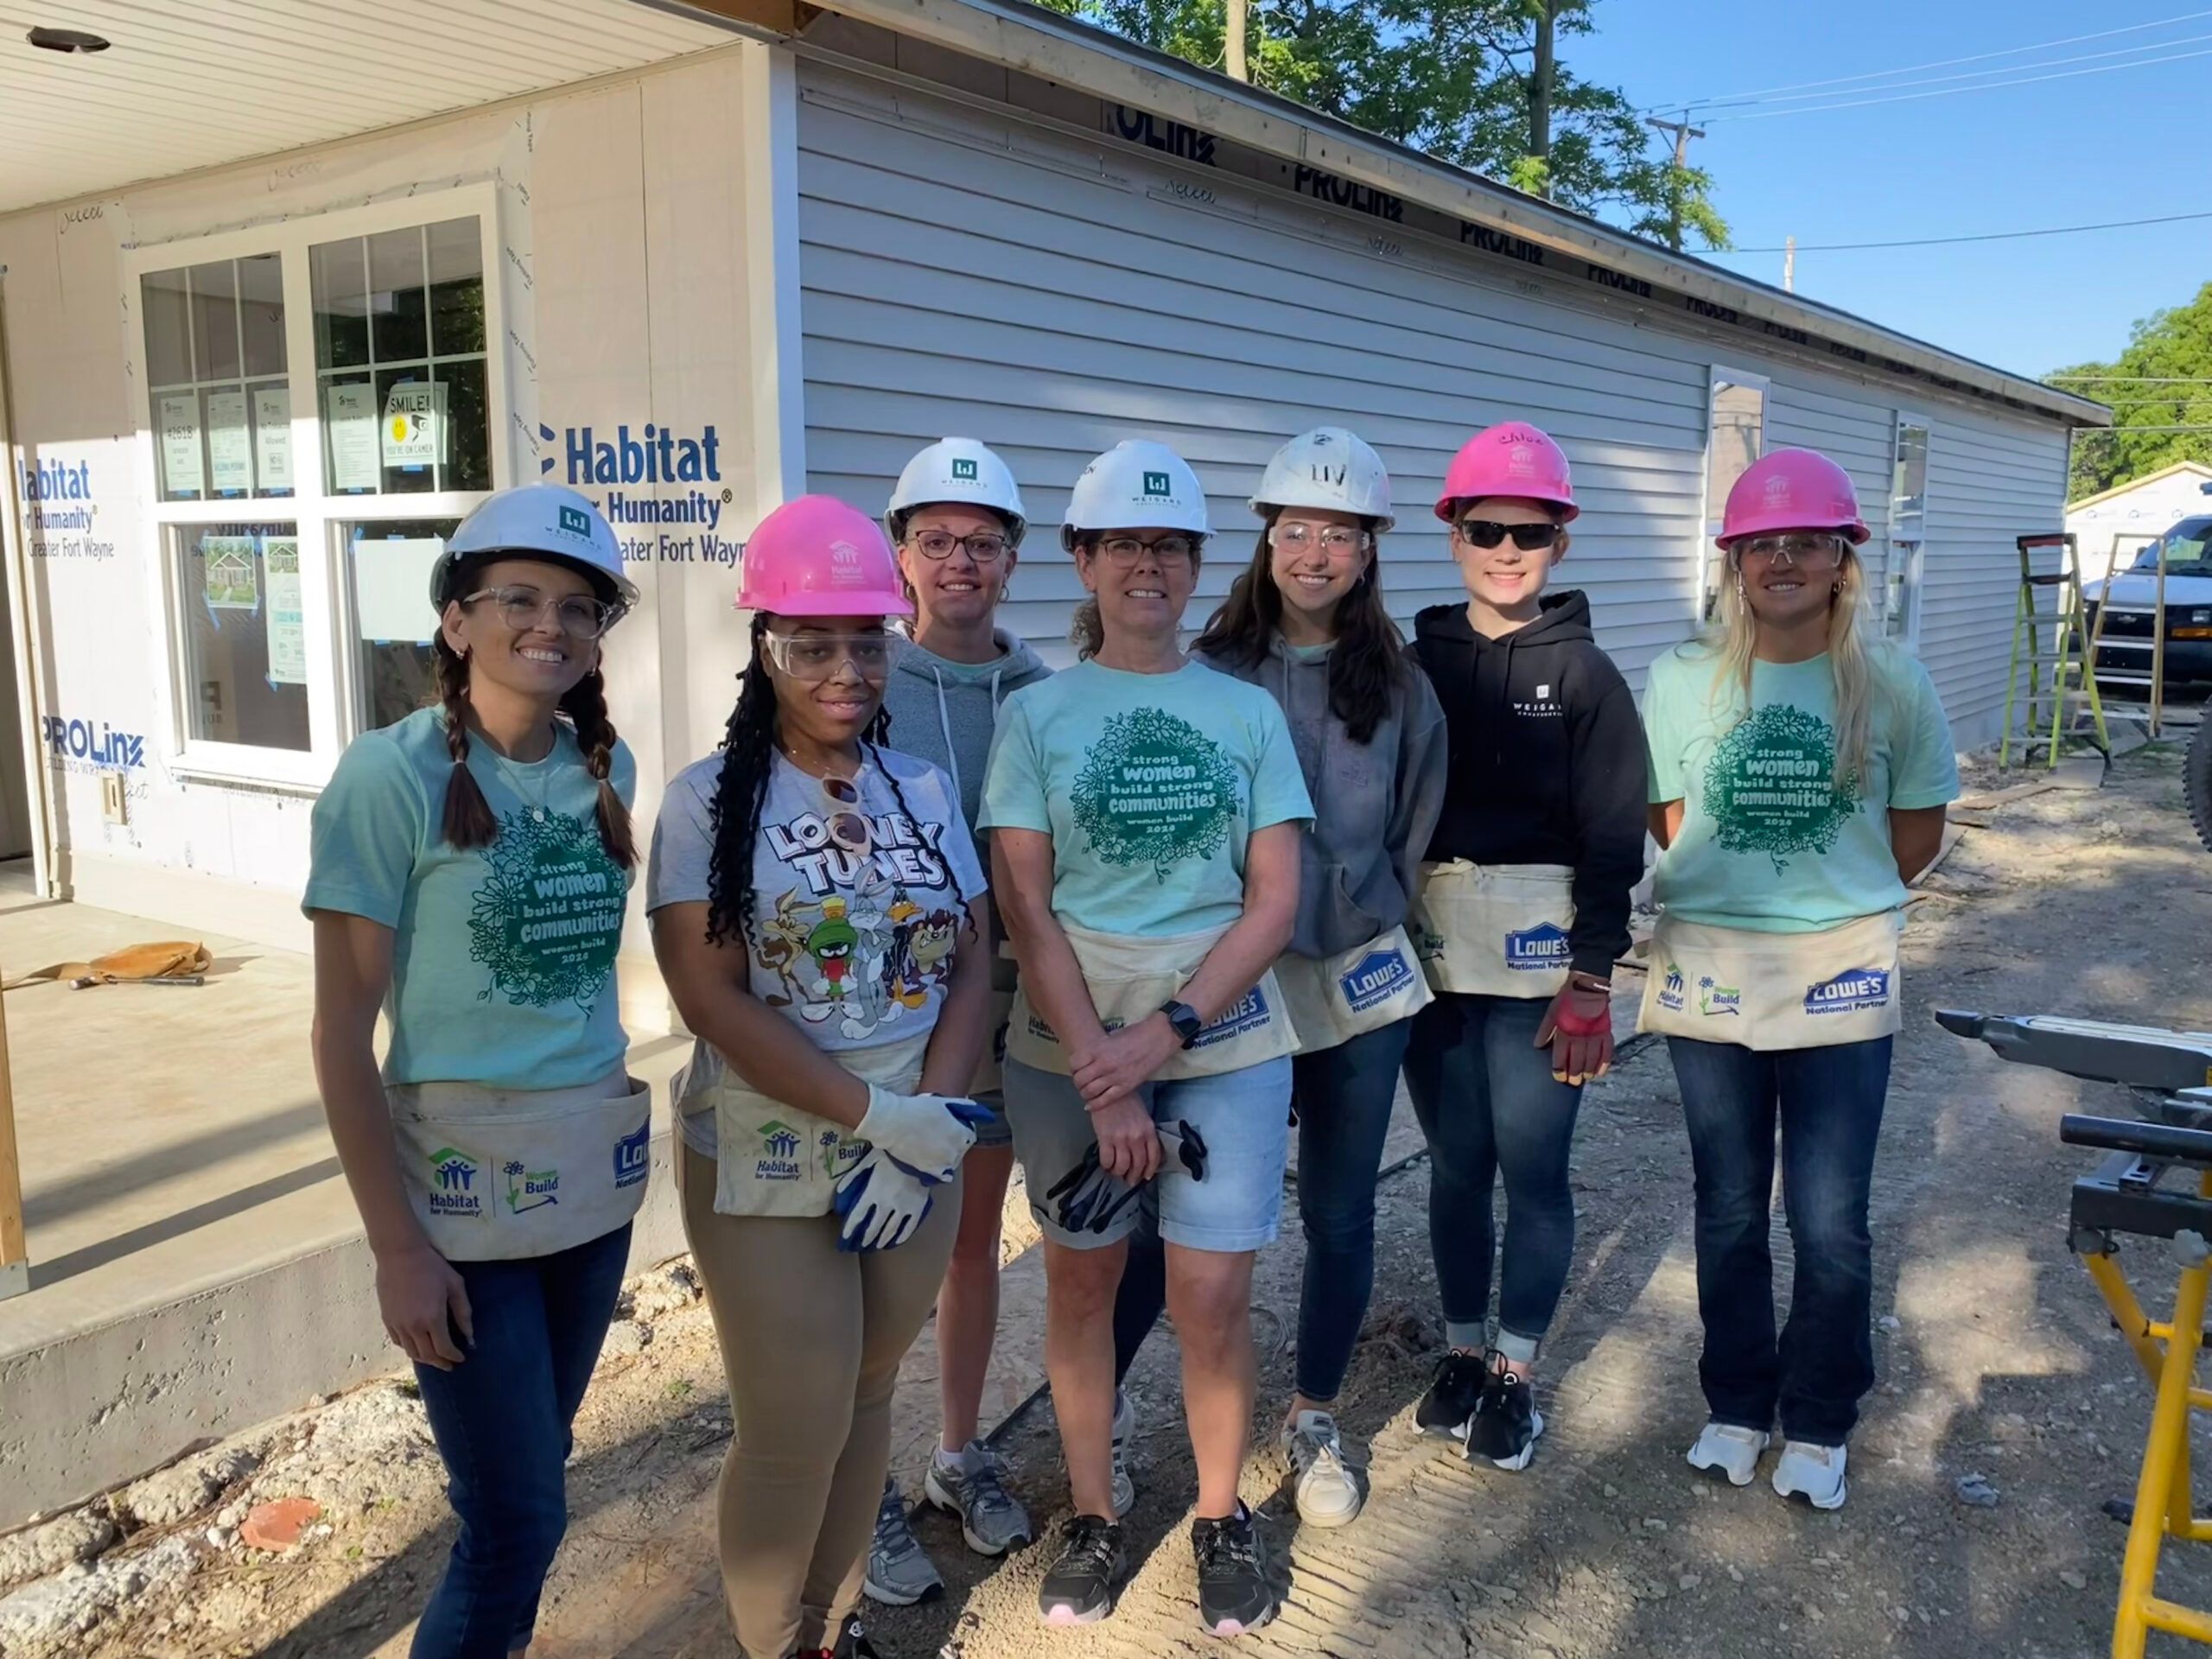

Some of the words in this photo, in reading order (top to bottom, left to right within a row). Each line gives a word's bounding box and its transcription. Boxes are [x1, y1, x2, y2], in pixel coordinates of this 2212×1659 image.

[391, 395, 430, 413] SMILE!
[566, 423, 721, 485] Habitat
[1312, 464, 1347, 486] LIV
[28, 537, 60, 557] Greater
[62, 537, 81, 557] Fort
[84, 537, 114, 562] Wayne
[621, 539, 653, 563] ater
[659, 535, 695, 562] Fort
[1513, 702, 1561, 711] WEIGA
[1133, 755, 1179, 765] strong
[1757, 749, 1803, 759] strong
[1110, 784, 1152, 794] build
[1159, 781, 1213, 793] strong
[1733, 778, 1773, 788] build
[1780, 779, 1832, 791] strong
[1166, 813, 1193, 823] build
[540, 861, 588, 875] strong
[523, 900, 568, 918] build
[573, 897, 620, 912] strong
[542, 944, 578, 955] women
[581, 937, 606, 950] build
[1507, 961, 1547, 970] National
[1349, 958, 1403, 996] LOWE'S
[1813, 976, 1882, 1001] LOWE'S
[1351, 990, 1391, 1014] National
[1713, 994, 1740, 1004] Build
[1806, 1005, 1852, 1015] National
[1195, 1028, 1237, 1049] National
[1239, 1015, 1270, 1034] Partner
[838, 1145, 863, 1160] Buil
[757, 1160, 799, 1173] Habitat
[525, 1169, 557, 1180] Women
[525, 1178, 559, 1194] Build
[430, 1193, 480, 1208] Habitat
